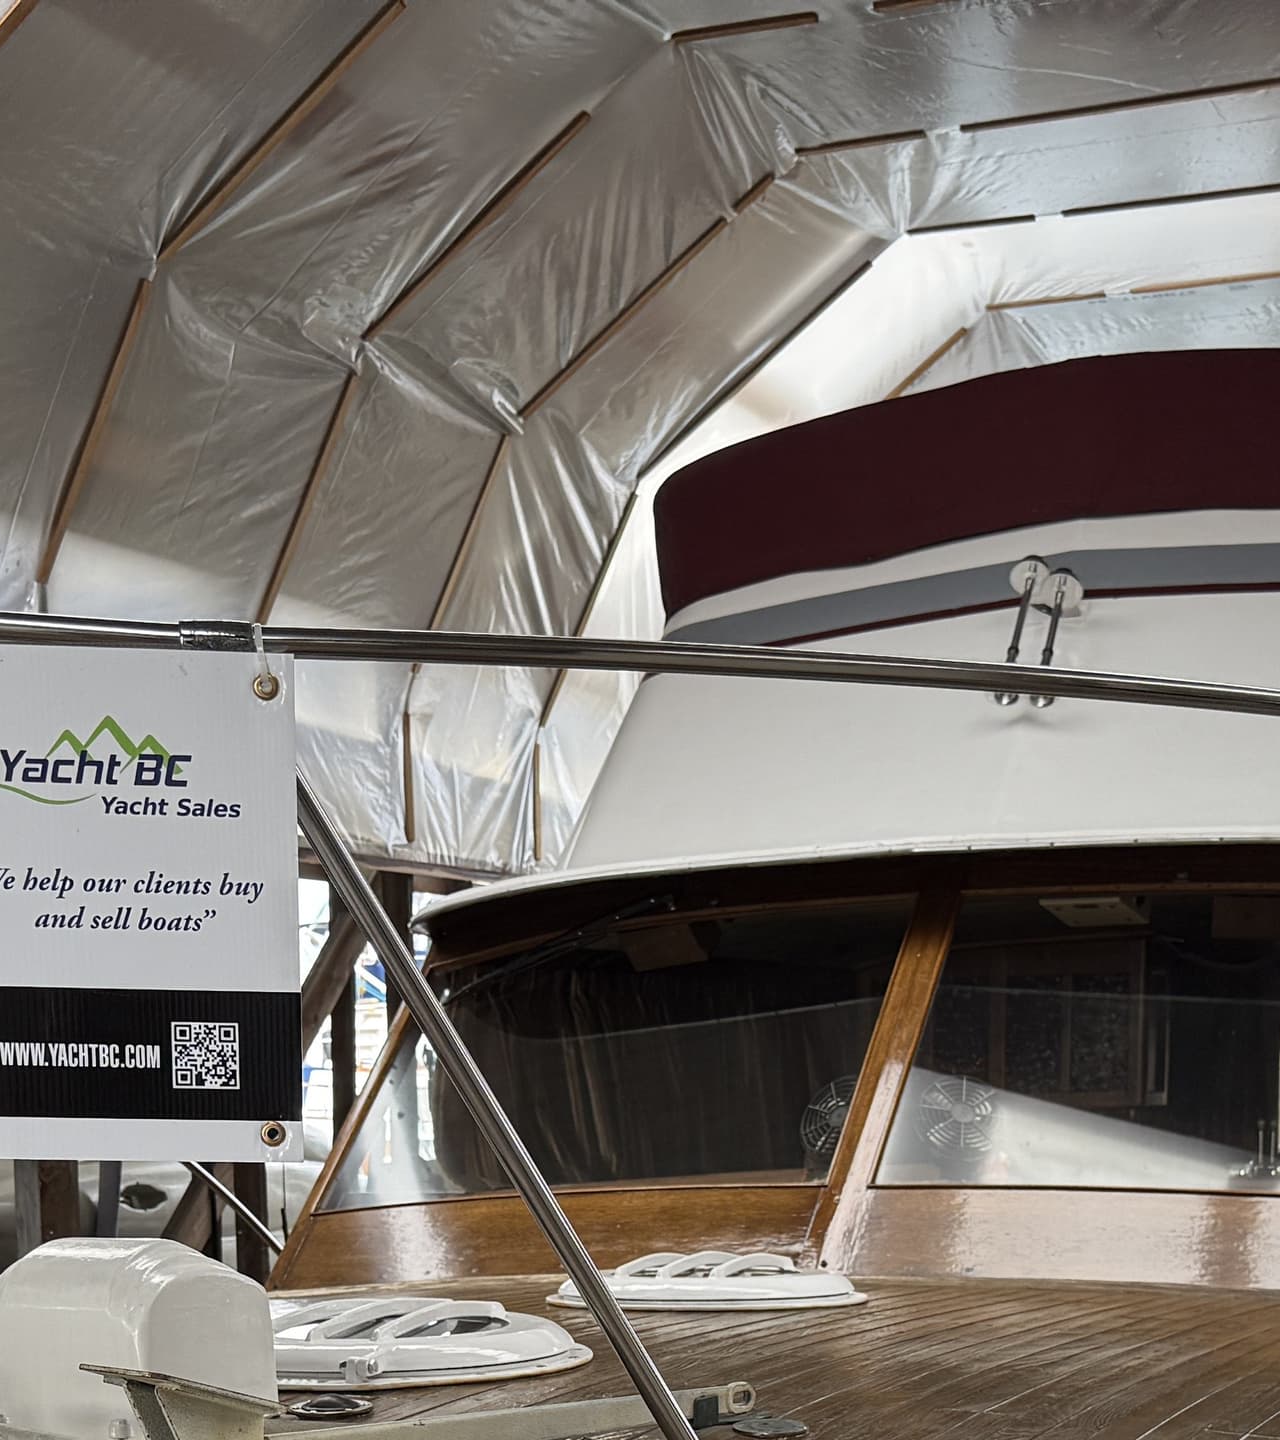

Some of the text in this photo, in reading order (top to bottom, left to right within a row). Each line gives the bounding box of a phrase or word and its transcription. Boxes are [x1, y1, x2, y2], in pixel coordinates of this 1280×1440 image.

[0, 748, 193, 788] Yacht BC
[100, 795, 242, 819] Yacht Sales
[22, 866, 75, 900] help
[82, 876, 128, 894] our
[132, 870, 213, 897] clients
[219, 872, 265, 905] buy
[34, 906, 87, 930] and
[89, 906, 133, 931] sell
